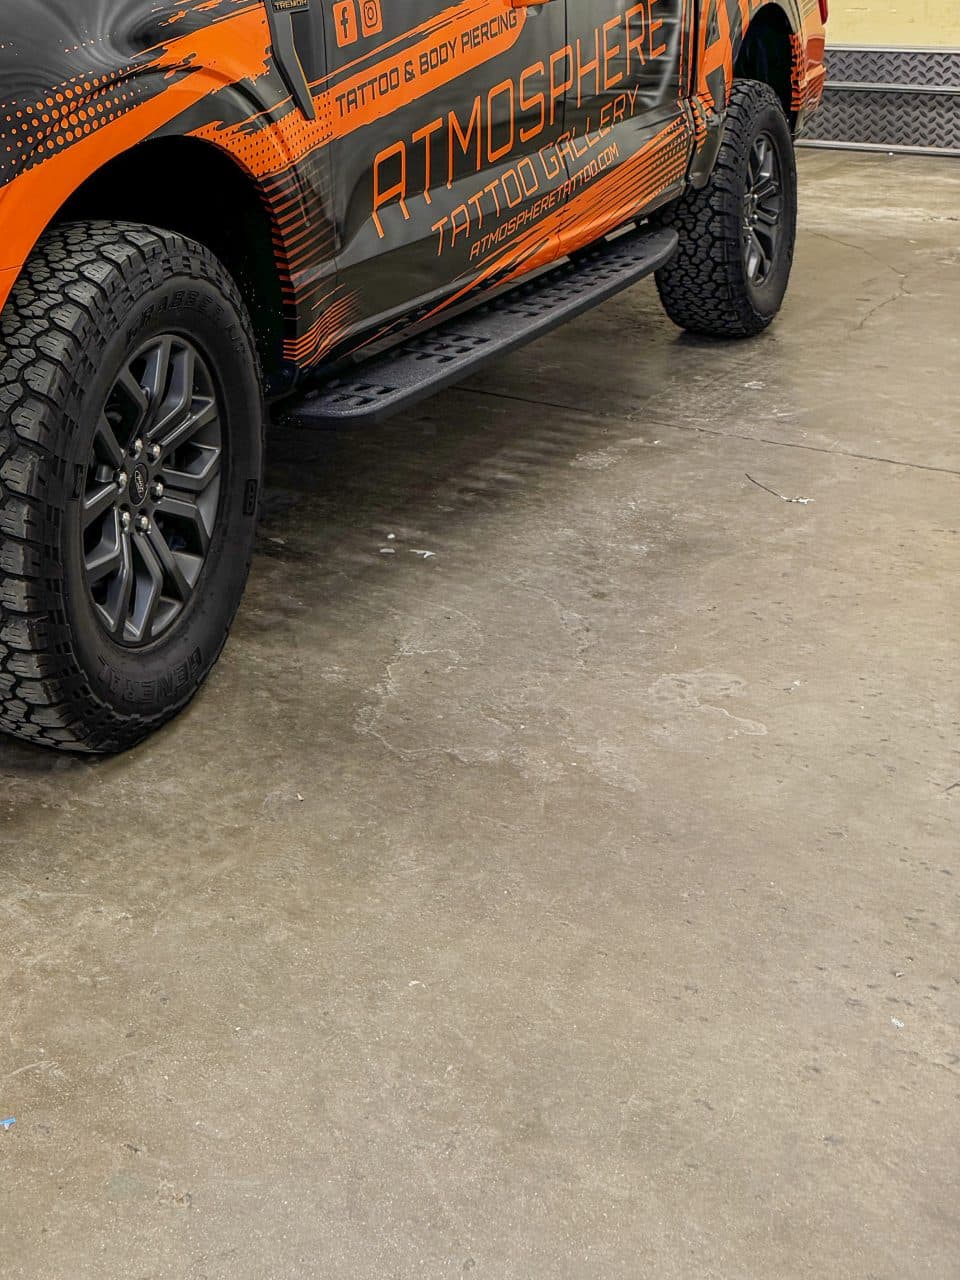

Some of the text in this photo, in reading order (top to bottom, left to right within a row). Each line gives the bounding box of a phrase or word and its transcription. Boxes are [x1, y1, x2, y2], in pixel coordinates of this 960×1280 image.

[335, 9, 518, 118] TATTOO & BODY PIERCING
[431, 84, 640, 257] TATTOO GALLERY
[469, 142, 620, 261] ATMOSPHERETATTOO.COM
